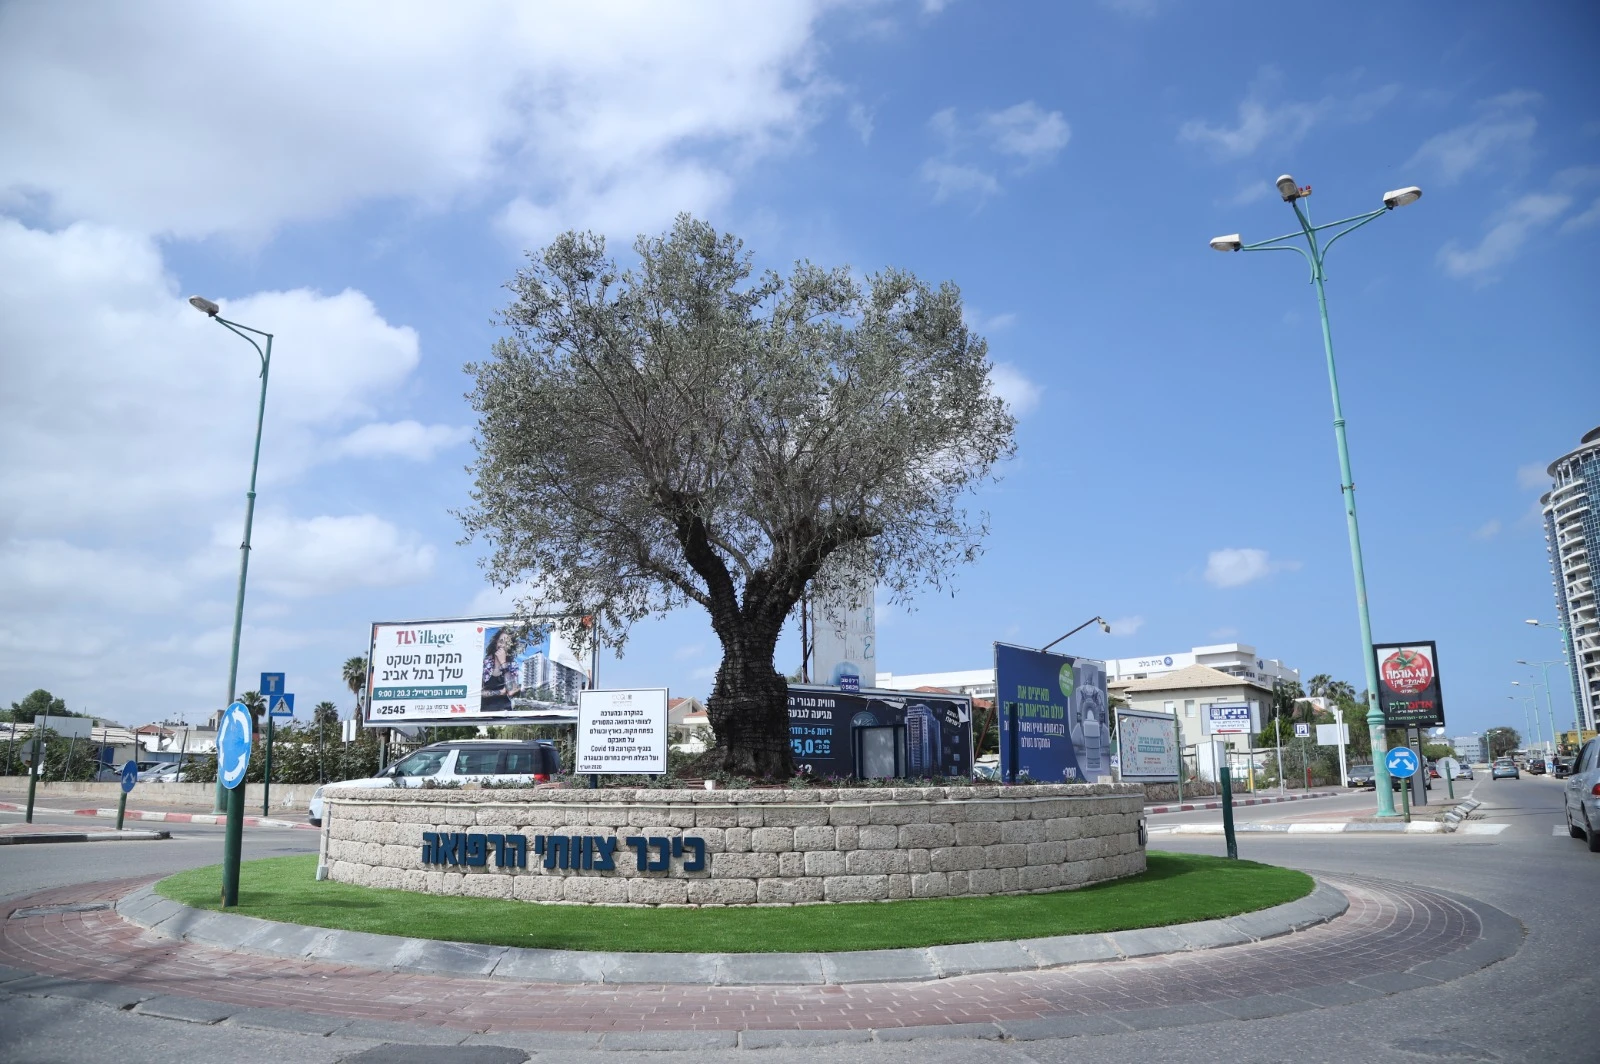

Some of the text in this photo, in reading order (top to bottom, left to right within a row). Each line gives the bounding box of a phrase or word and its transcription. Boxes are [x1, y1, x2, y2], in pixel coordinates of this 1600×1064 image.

[386, 653, 462, 668] המקום השקט
[381, 666, 463, 682] שלך בתל אביב
[378, 690, 392, 698] 9:00
[444, 688, 463, 696] אירוע
[1017, 684, 1049, 702] מאיצים את
[797, 697, 816, 707] מגורי
[817, 698, 835, 708] חווית
[811, 710, 832, 720] מגיעה
[1025, 703, 1050, 719] הבריאות
[1050, 702, 1064, 720] עולם
[804, 727, 816, 735] 3-6
[421, 831, 705, 872] כיכר צוותי הרפואה
